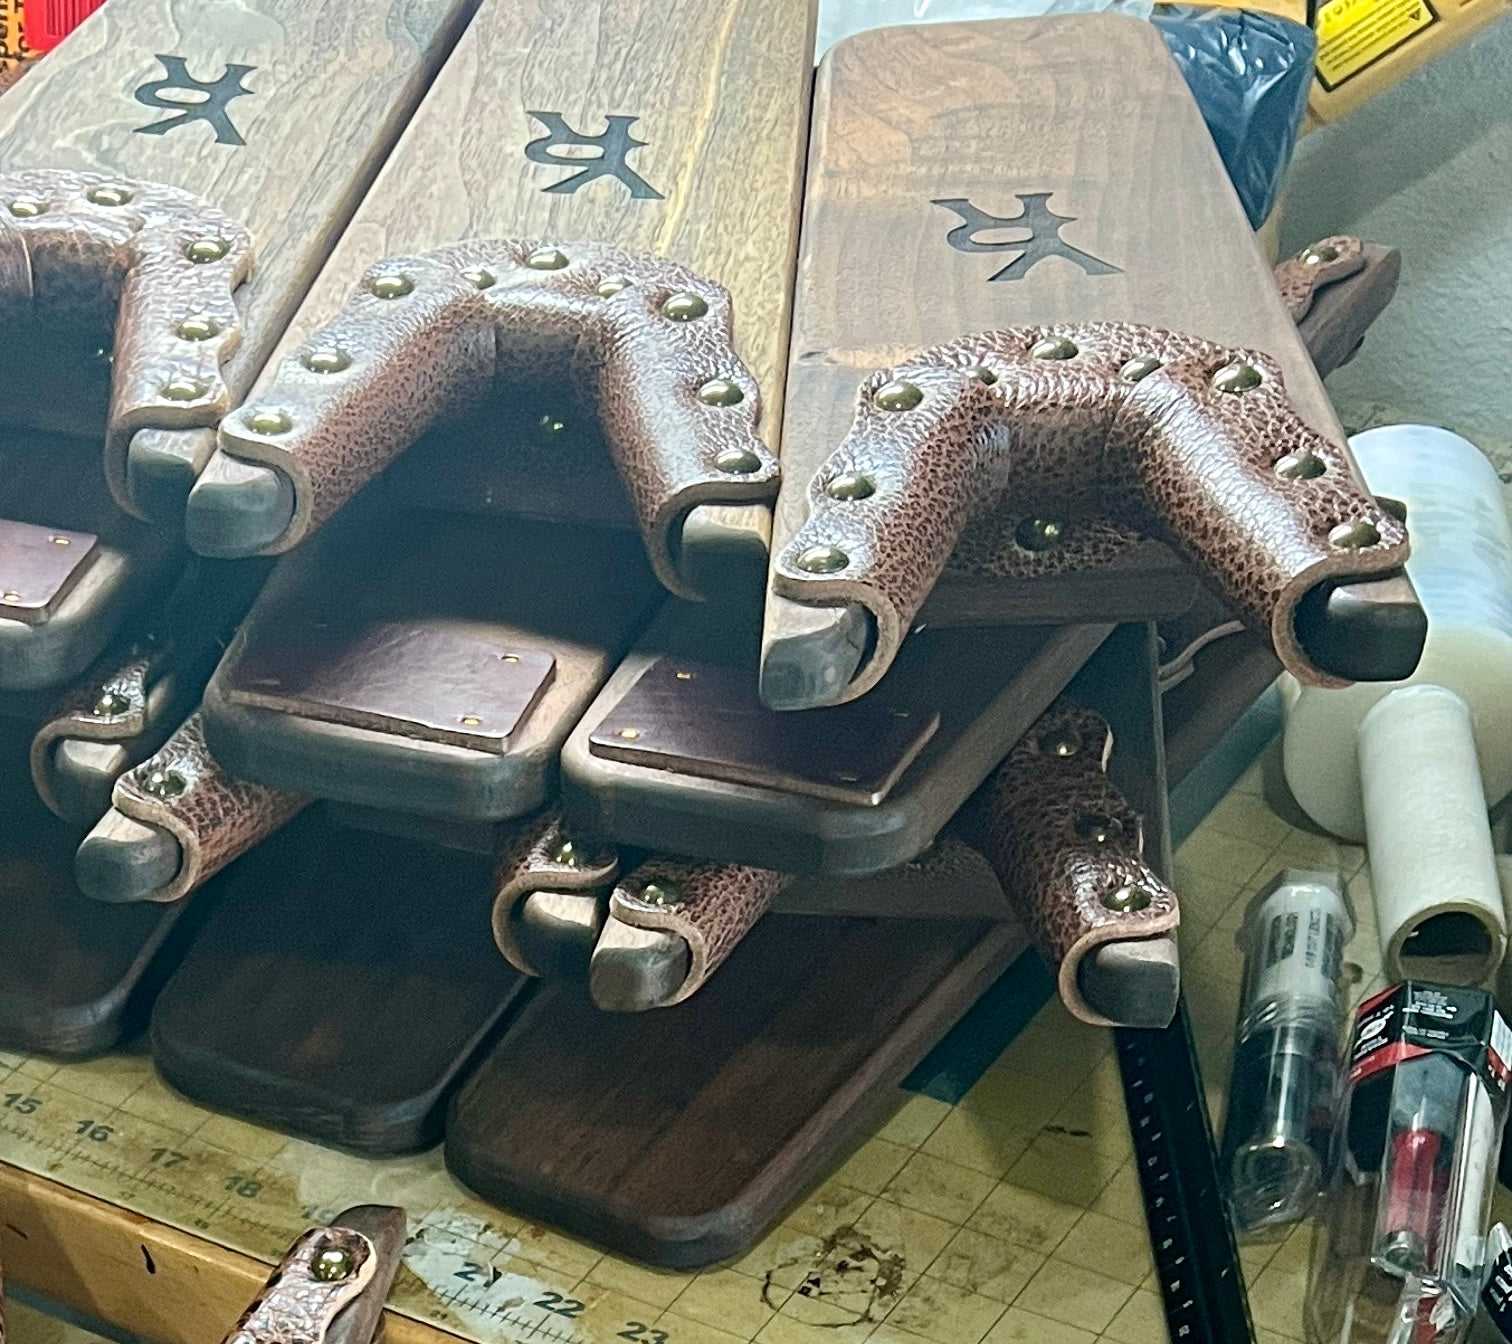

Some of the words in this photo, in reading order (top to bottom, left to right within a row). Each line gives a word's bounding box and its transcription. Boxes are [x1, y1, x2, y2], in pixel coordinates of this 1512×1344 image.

[4, 1093, 43, 1114] 15
[76, 1120, 114, 1141] 16
[150, 1149, 189, 1168] 17
[225, 1176, 262, 1197] 18
[533, 1291, 585, 1318] 22
